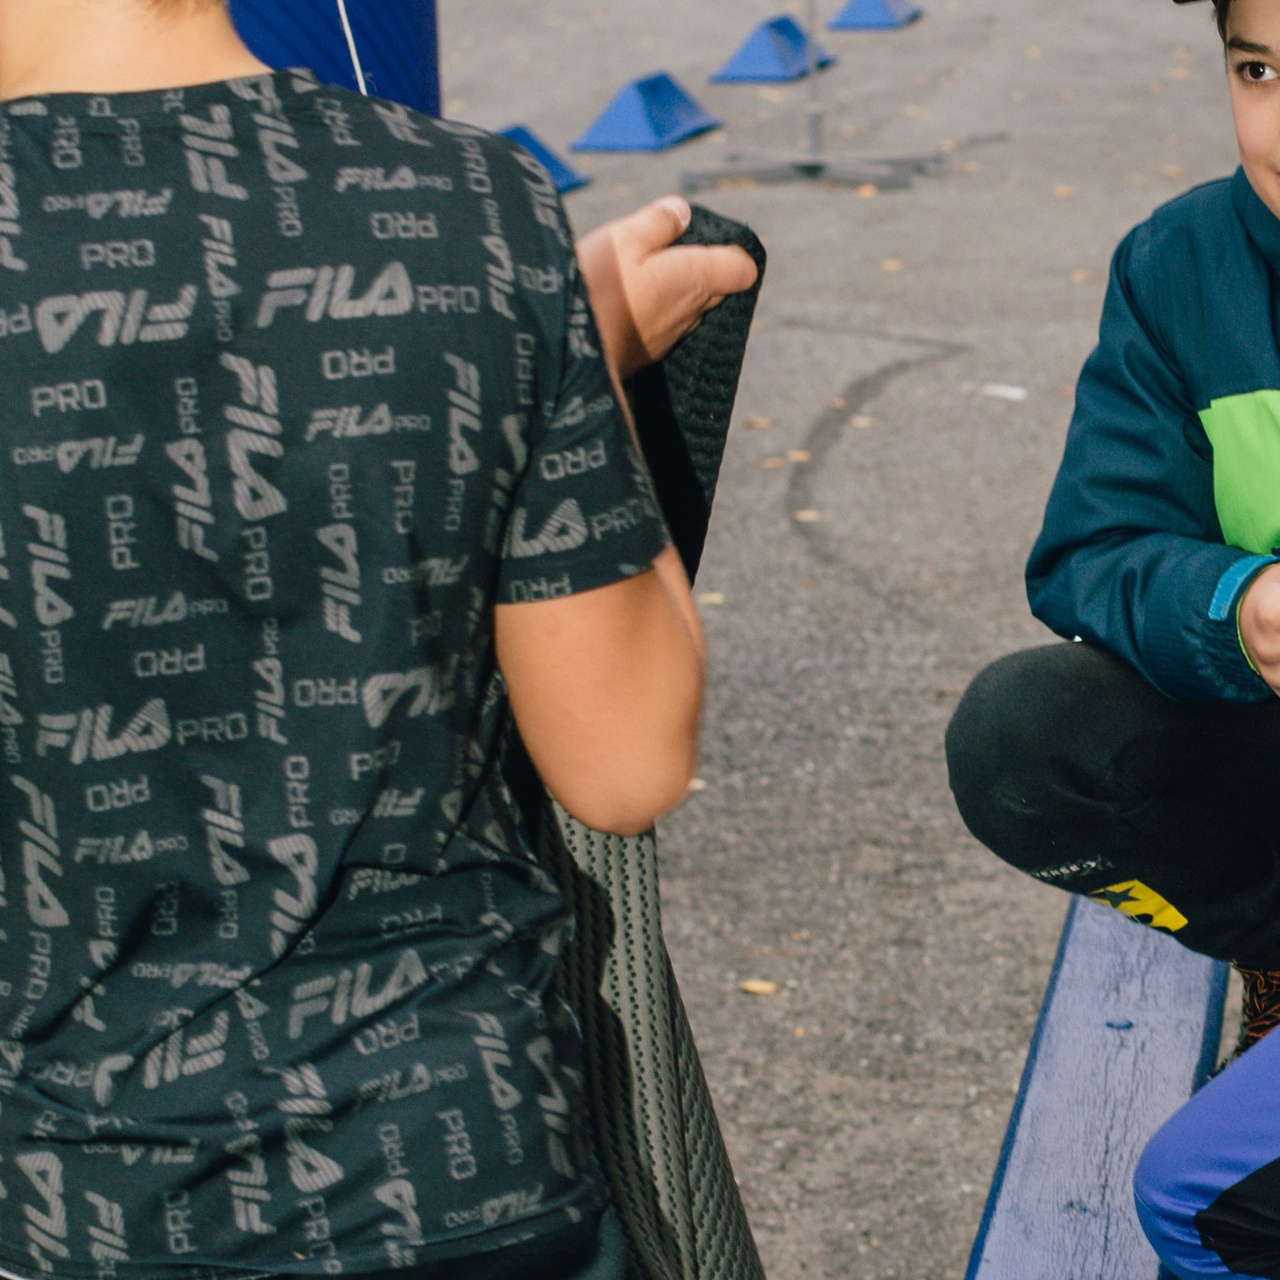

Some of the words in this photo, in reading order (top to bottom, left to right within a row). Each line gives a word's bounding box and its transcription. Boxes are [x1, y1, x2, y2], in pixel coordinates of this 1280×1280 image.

[179, 103, 250, 200] FIL
[333, 166, 416, 194] FILA
[453, 136, 493, 195] PRO
[85, 187, 174, 219] FILA
[272, 185, 304, 238] PRO
[370, 211, 440, 240] PRO
[80, 238, 156, 270] PRO
[198, 213, 242, 298] FILA
[481, 234, 518, 321] FILA
[34, 283, 199, 355] FILA
[255, 261, 414, 328] FILA
[414, 285, 481, 314] PRO
[320, 344, 396, 381] PRO
[31, 378, 108, 418] PRO
[174, 376, 202, 435] PRO
[303, 402, 393, 443] FILA
[442, 350, 482, 476] FILA
[12, 446, 56, 466] PRO
[55, 433, 145, 475] FILA
[219, 351, 288, 521] FILA
[539, 439, 609, 482] PRO
[164, 437, 220, 563] FILA
[328, 462, 354, 520] PRO
[389, 460, 417, 535] PRO
[444, 478, 466, 533] PRO
[21, 503, 76, 627] FILA
[105, 494, 141, 571] PRO
[241, 525, 274, 602] PRO
[101, 590, 188, 631] FILA
[188, 598, 229, 618] PRO
[316, 523, 363, 644] FILA
[40, 629, 65, 685] PRO
[135, 642, 206, 678] PRO
[253, 657, 289, 746] FILA
[292, 677, 359, 708] PRO
[34, 697, 172, 766] FILA
[175, 712, 250, 747] PRO
[85, 774, 152, 812] PRO
[284, 755, 315, 828] PRO
[10, 774, 71, 927] FILA
[73, 829, 153, 864] FILA
[200, 774, 251, 886] FILA
[23, 929, 52, 1001] PRO
[287, 947, 429, 1041] FILA
[352, 1013, 422, 1056] PRO
[455, 1009, 524, 1112] FILA
[260, 1062, 345, 1194] FILA
[378, 1123, 409, 1176] PRO
[435, 1108, 478, 1181] PRO
[223, 1132, 278, 1236] FILA
[163, 1190, 200, 1255] PRO
